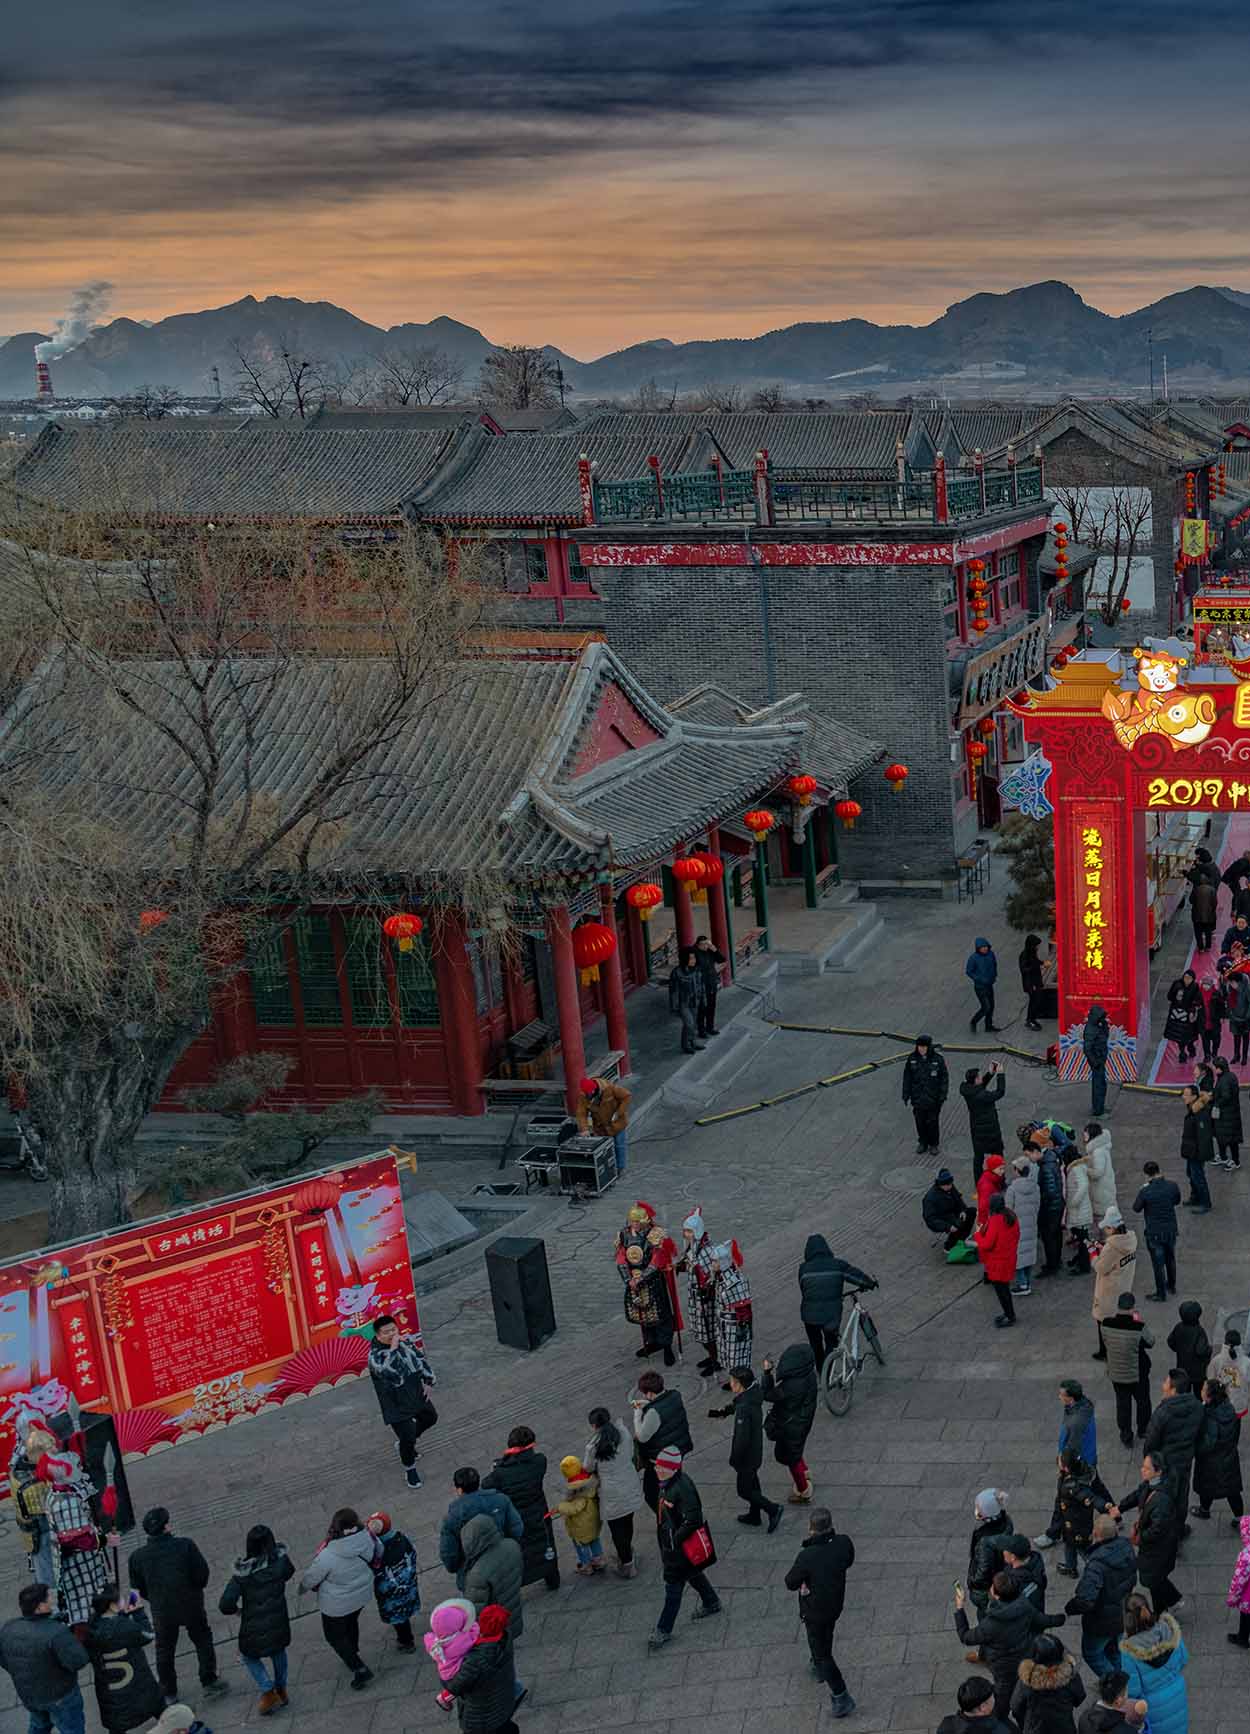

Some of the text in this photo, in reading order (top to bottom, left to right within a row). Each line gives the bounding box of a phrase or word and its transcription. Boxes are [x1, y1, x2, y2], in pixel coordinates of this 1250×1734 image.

[1148, 778, 1224, 807] 2019
[193, 1370, 246, 1401] 2019
[102, 1648, 134, 1690] 5
